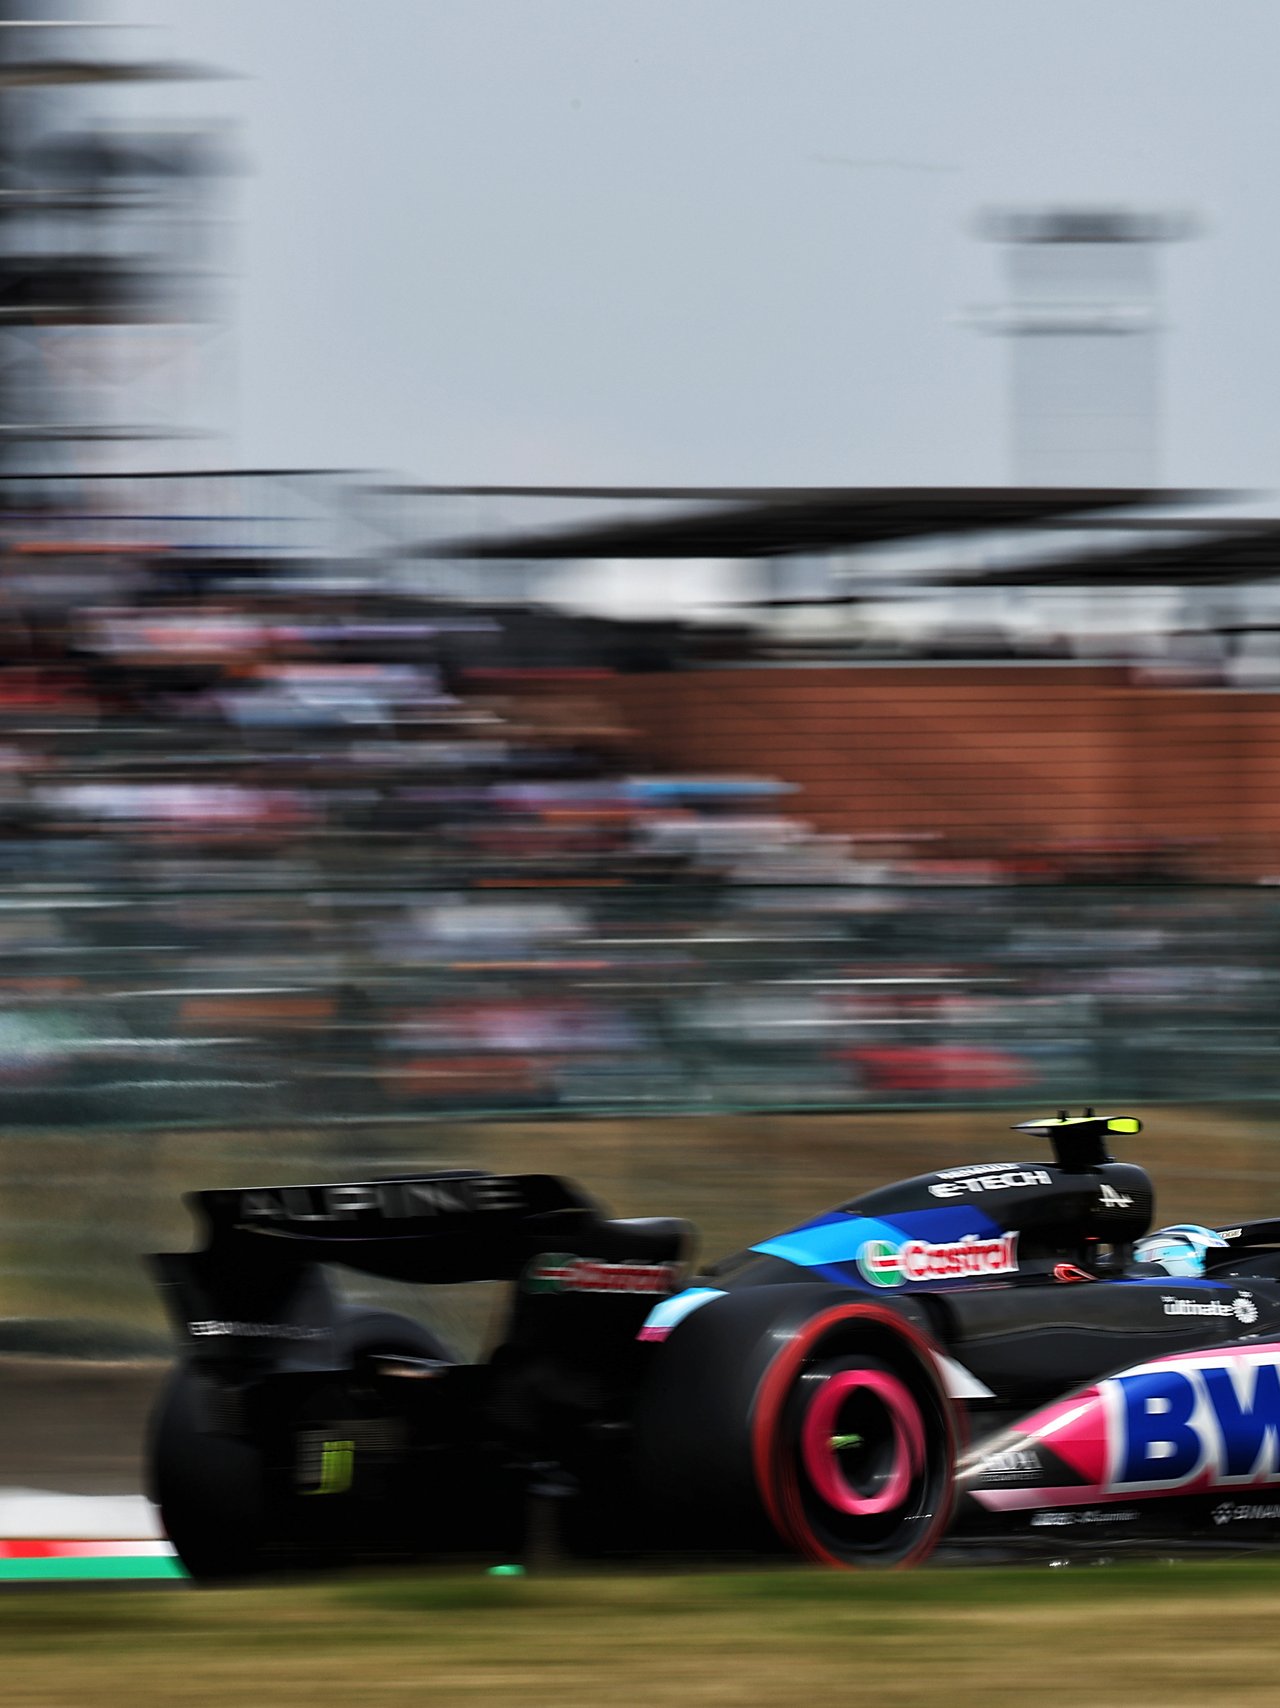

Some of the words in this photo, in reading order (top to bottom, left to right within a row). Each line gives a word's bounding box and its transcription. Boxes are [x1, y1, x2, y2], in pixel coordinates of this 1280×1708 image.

[238, 1178, 524, 1222] ALPINE
[928, 1171, 1052, 1198] E-TECH
[904, 1231, 1020, 1281] Castrol
